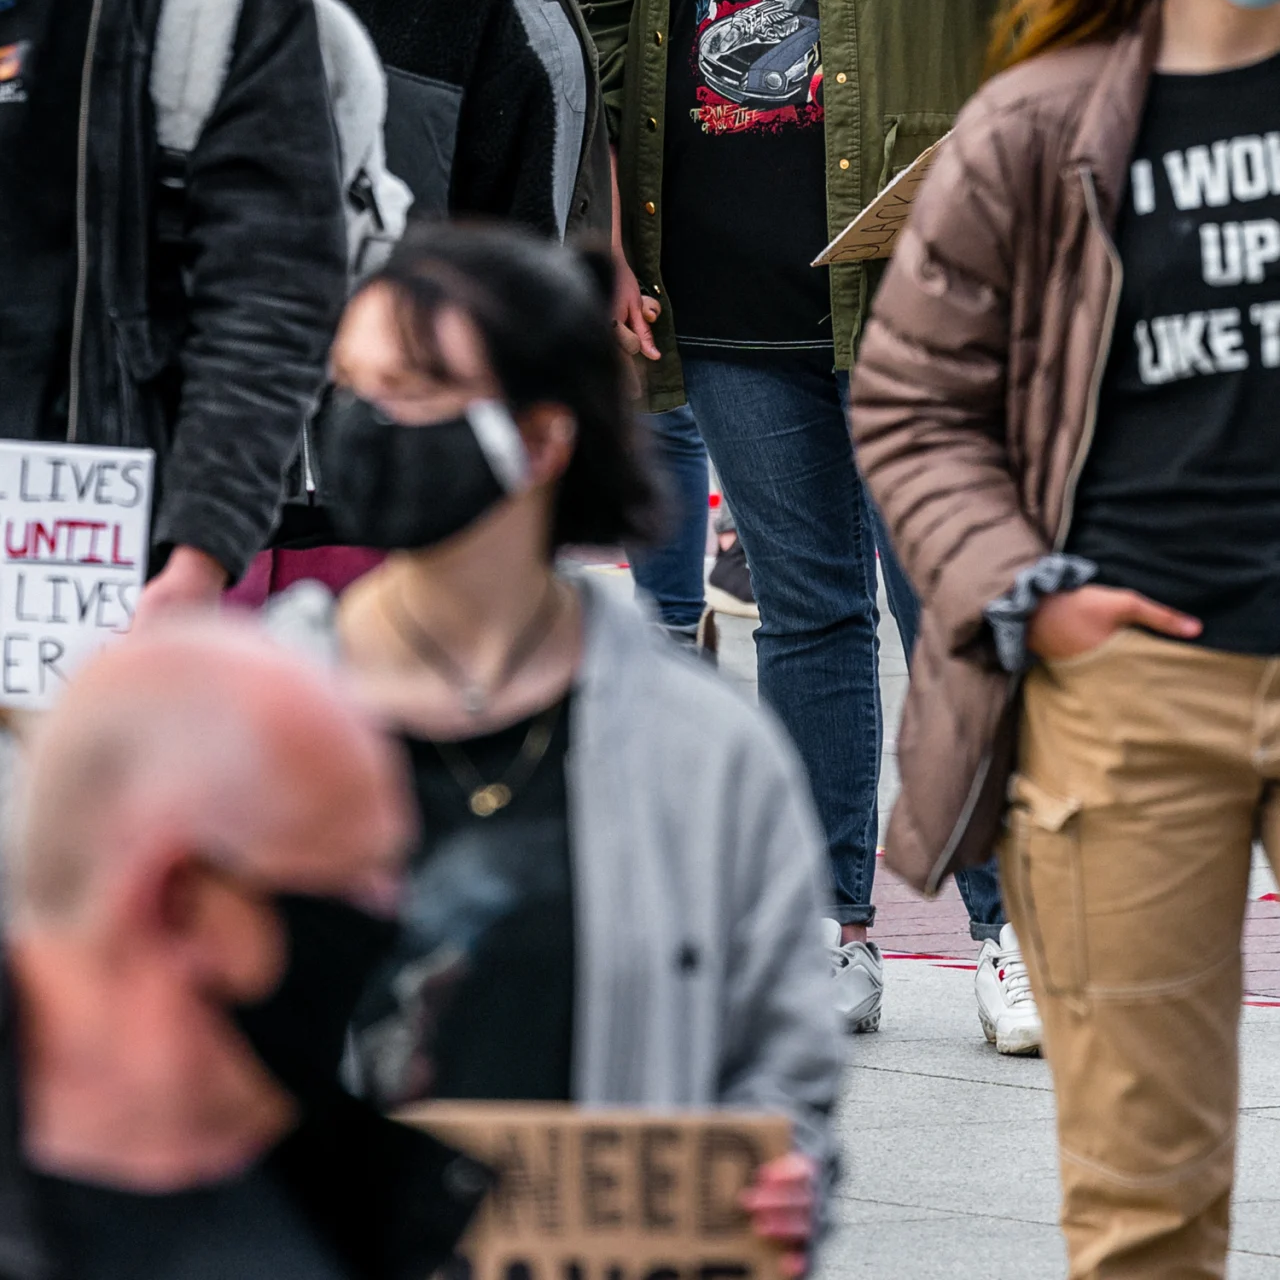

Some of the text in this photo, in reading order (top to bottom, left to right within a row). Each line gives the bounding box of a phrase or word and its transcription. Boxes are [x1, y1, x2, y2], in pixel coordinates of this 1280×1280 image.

[1130, 157, 1157, 216] I
[1133, 306, 1250, 386] LIKE
[19, 456, 146, 509] LIVES
[4, 517, 136, 567] UNTIL
[15, 571, 137, 635] LIVES
